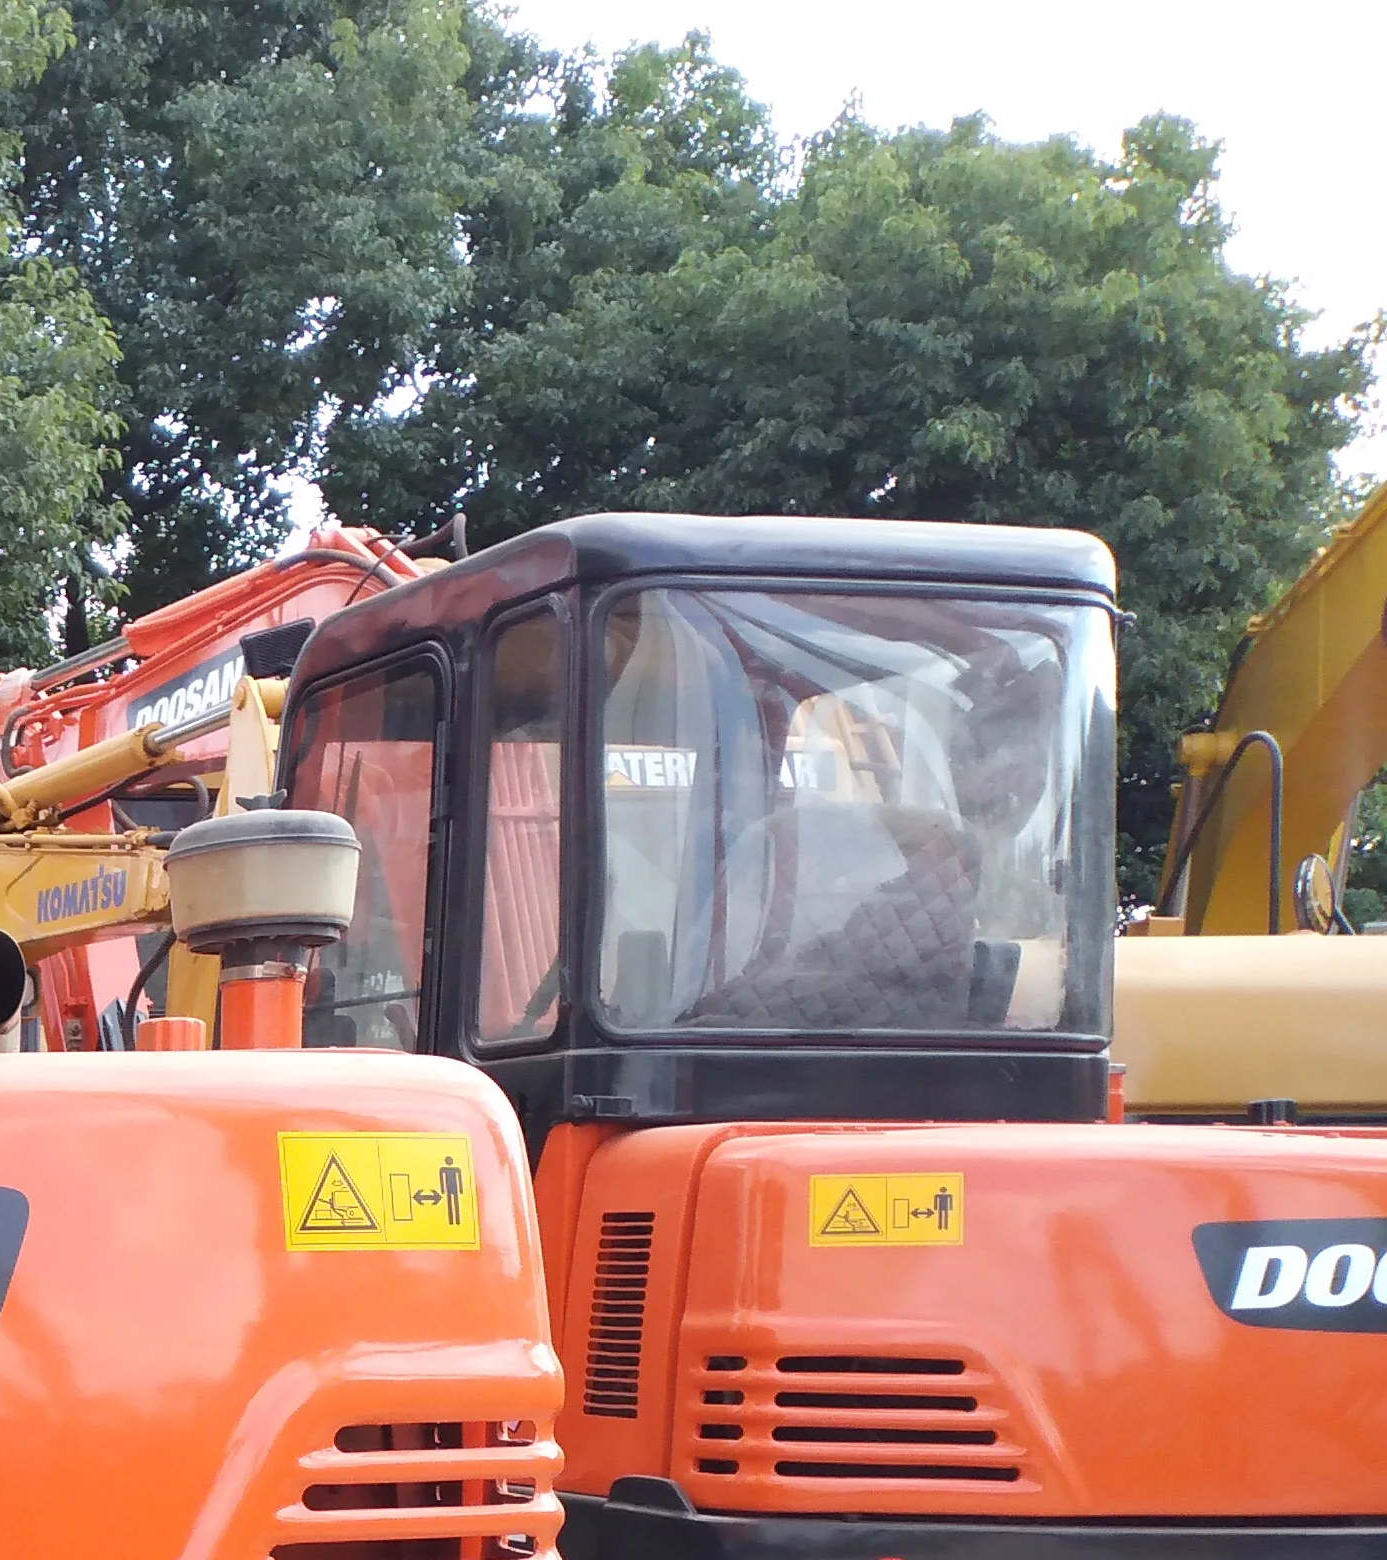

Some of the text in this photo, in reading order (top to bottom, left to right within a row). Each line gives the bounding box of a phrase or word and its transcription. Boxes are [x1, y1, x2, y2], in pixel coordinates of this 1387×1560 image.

[135, 655, 244, 728] DOOSAN
[36, 865, 127, 924] KOMATSU
[1231, 1244, 1387, 1309] DO
